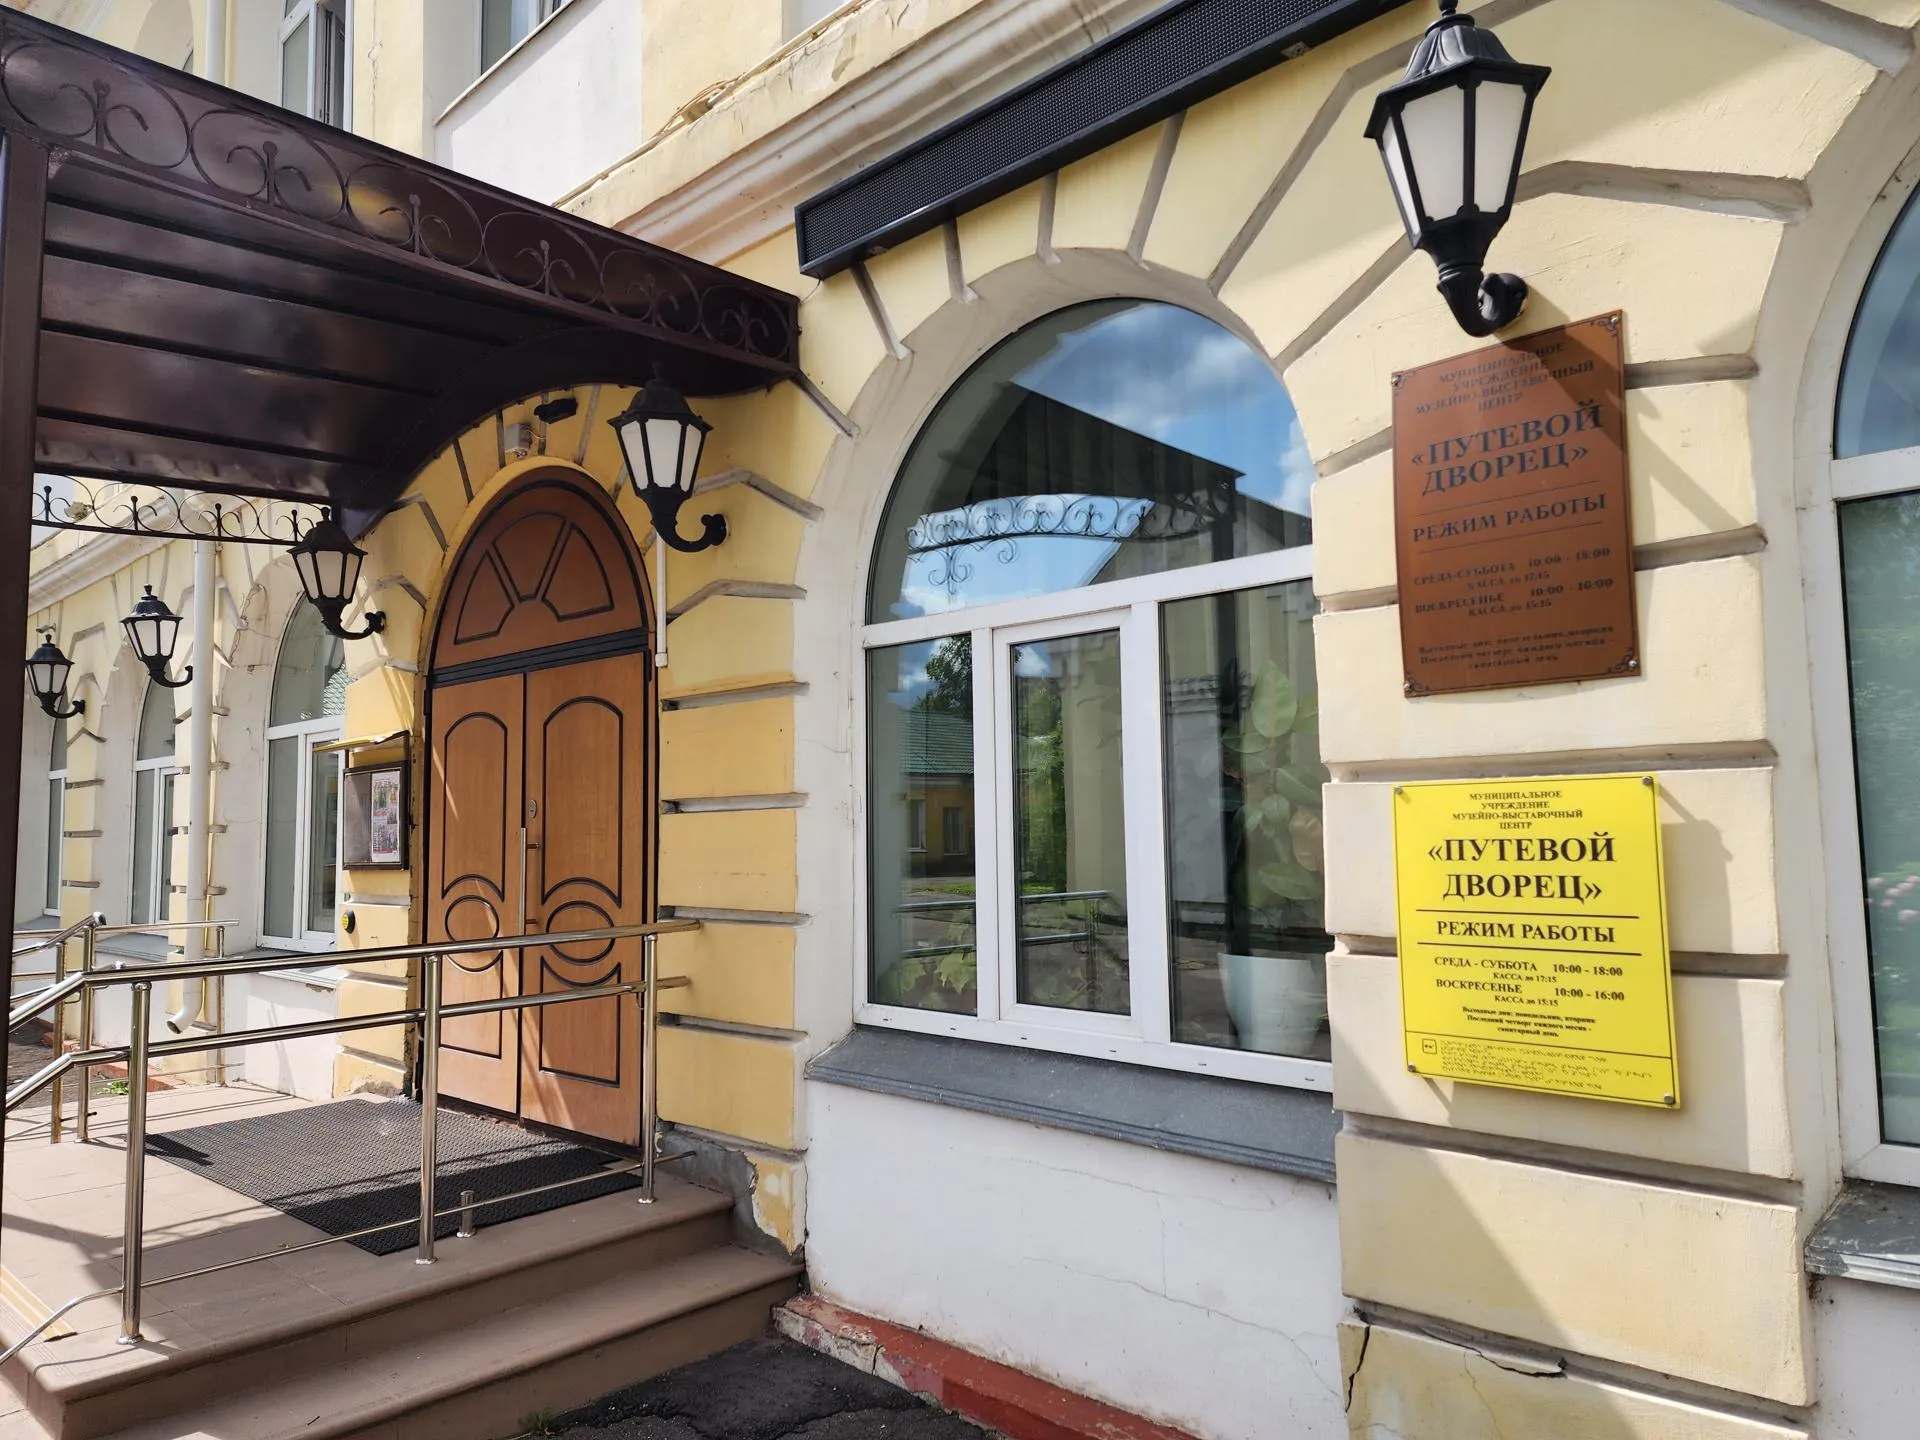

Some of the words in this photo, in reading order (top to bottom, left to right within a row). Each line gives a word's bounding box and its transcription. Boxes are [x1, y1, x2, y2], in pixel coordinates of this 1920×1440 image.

[1478, 392, 1523, 412] ЦЕНТР
[1411, 398, 1604, 466] «ПУТЕВОЙ
[1421, 443, 1588, 496] ДВОРЕЦ»
[1413, 514, 1497, 543] РЕЖИМ
[1506, 494, 1606, 526] РАБОТЫ
[1528, 555, 1561, 568] 10:00
[1576, 547, 1611, 562] 18:00
[1525, 571, 1550, 581] 17:15
[1531, 584, 1564, 597] 10:00
[1578, 578, 1613, 591] 16:00
[1526, 599, 1552, 609] 15:15
[1469, 791, 1562, 800] МУНИЦИПАЛЬНОЕ
[1481, 801, 1550, 810] УЧРЕЖДЕНИЕ
[1452, 809, 1583, 821] МУЗЕЙНО-ВЫСТАВОЧНЫЙ
[1499, 822, 1532, 830] ЦЕНТР
[1428, 831, 1616, 862] «ПУТЕВОЙ
[1442, 873, 1602, 904] ДВОРЕЦ»
[1437, 920, 1515, 939] РЕЖИМ
[1521, 923, 1615, 943] РАБОТЫ
[1434, 956, 1472, 968] СРЕДА
[1481, 959, 1538, 972] СУББОТА
[1553, 963, 1582, 974] 10:00
[1593, 966, 1623, 976] 18:00
[1493, 972, 1522, 981] КАССА
[1536, 975, 1557, 983] 17:15
[1436, 979, 1522, 994] ВОСКРЕСЕНЬЕ
[1554, 987, 1583, 998] 10:00
[1595, 990, 1624, 1001] 16:00
[1495, 995, 1524, 1004] КАССА
[1538, 998, 1559, 1006] 15:15
